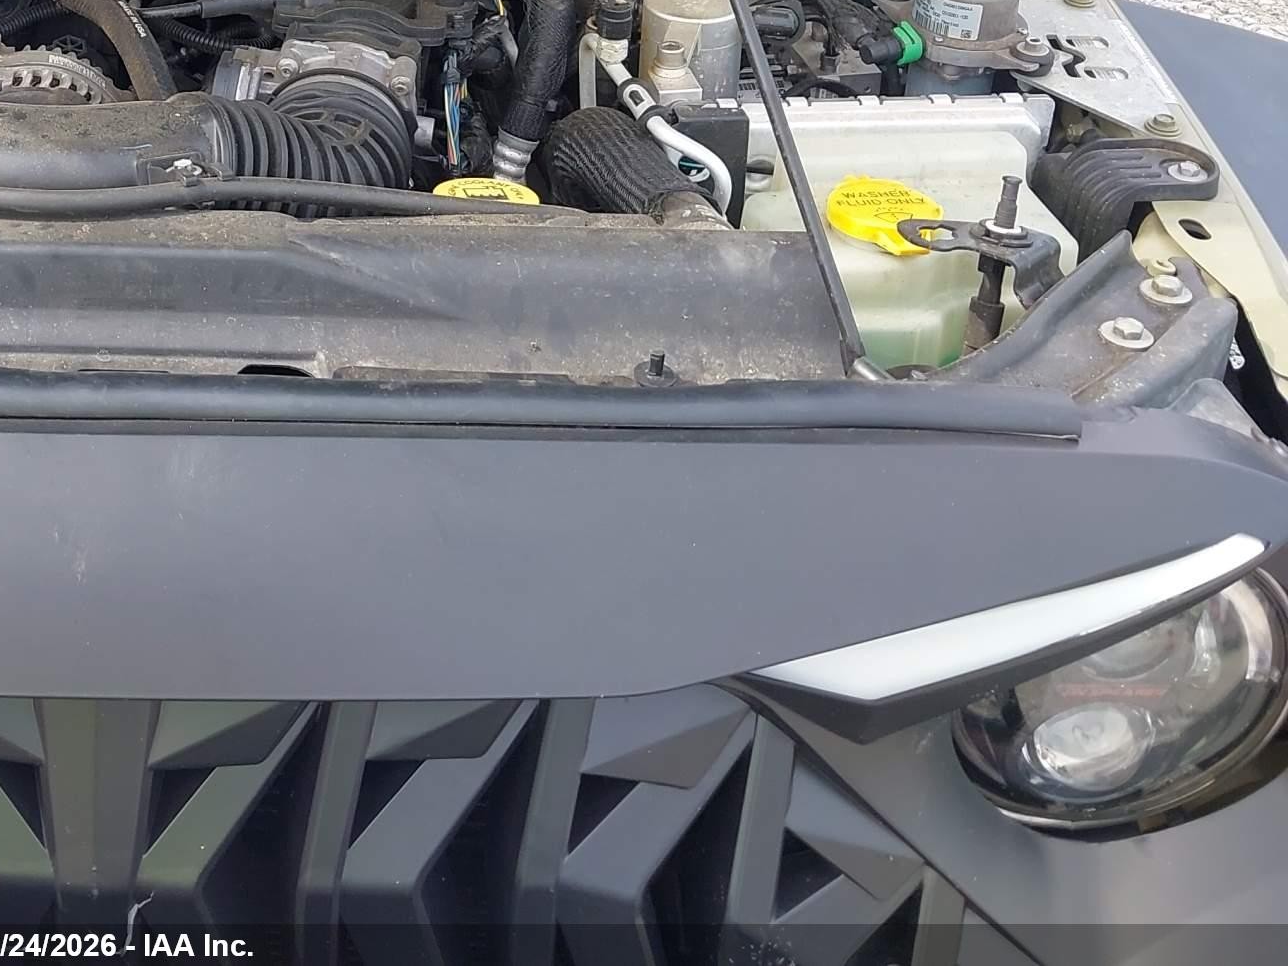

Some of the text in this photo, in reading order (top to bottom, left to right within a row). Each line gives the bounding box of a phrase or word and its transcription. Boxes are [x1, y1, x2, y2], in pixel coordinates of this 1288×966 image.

[841, 190, 911, 199] WASHER
[836, 197, 925, 207] FLUID ONLY
